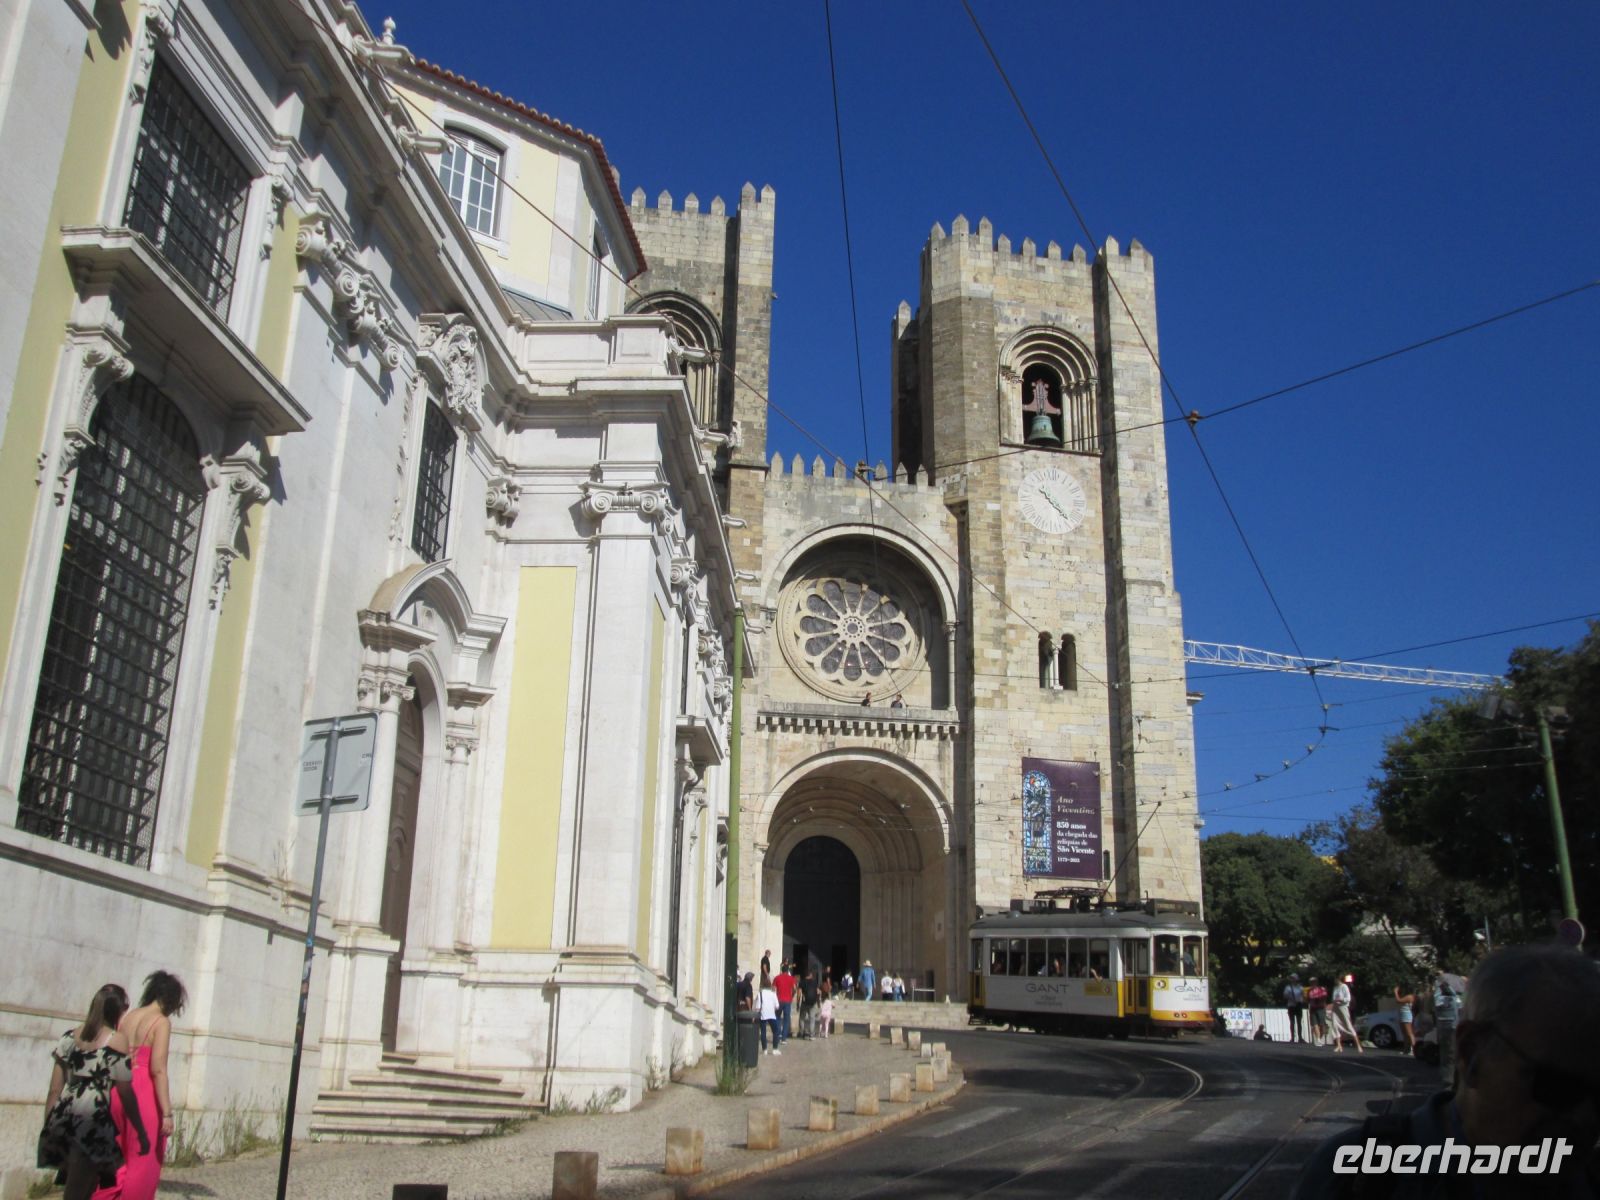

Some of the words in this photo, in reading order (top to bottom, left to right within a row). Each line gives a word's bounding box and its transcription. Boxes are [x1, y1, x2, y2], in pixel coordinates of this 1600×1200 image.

[1056, 796, 1074, 804] Ano
[1056, 821, 1070, 829] 850
[1065, 831, 1087, 839] chegada
[1088, 831, 1098, 839] das
[1056, 845, 1070, 853] São
[1071, 846, 1096, 855] Vicente
[1025, 983, 1069, 994] GANT
